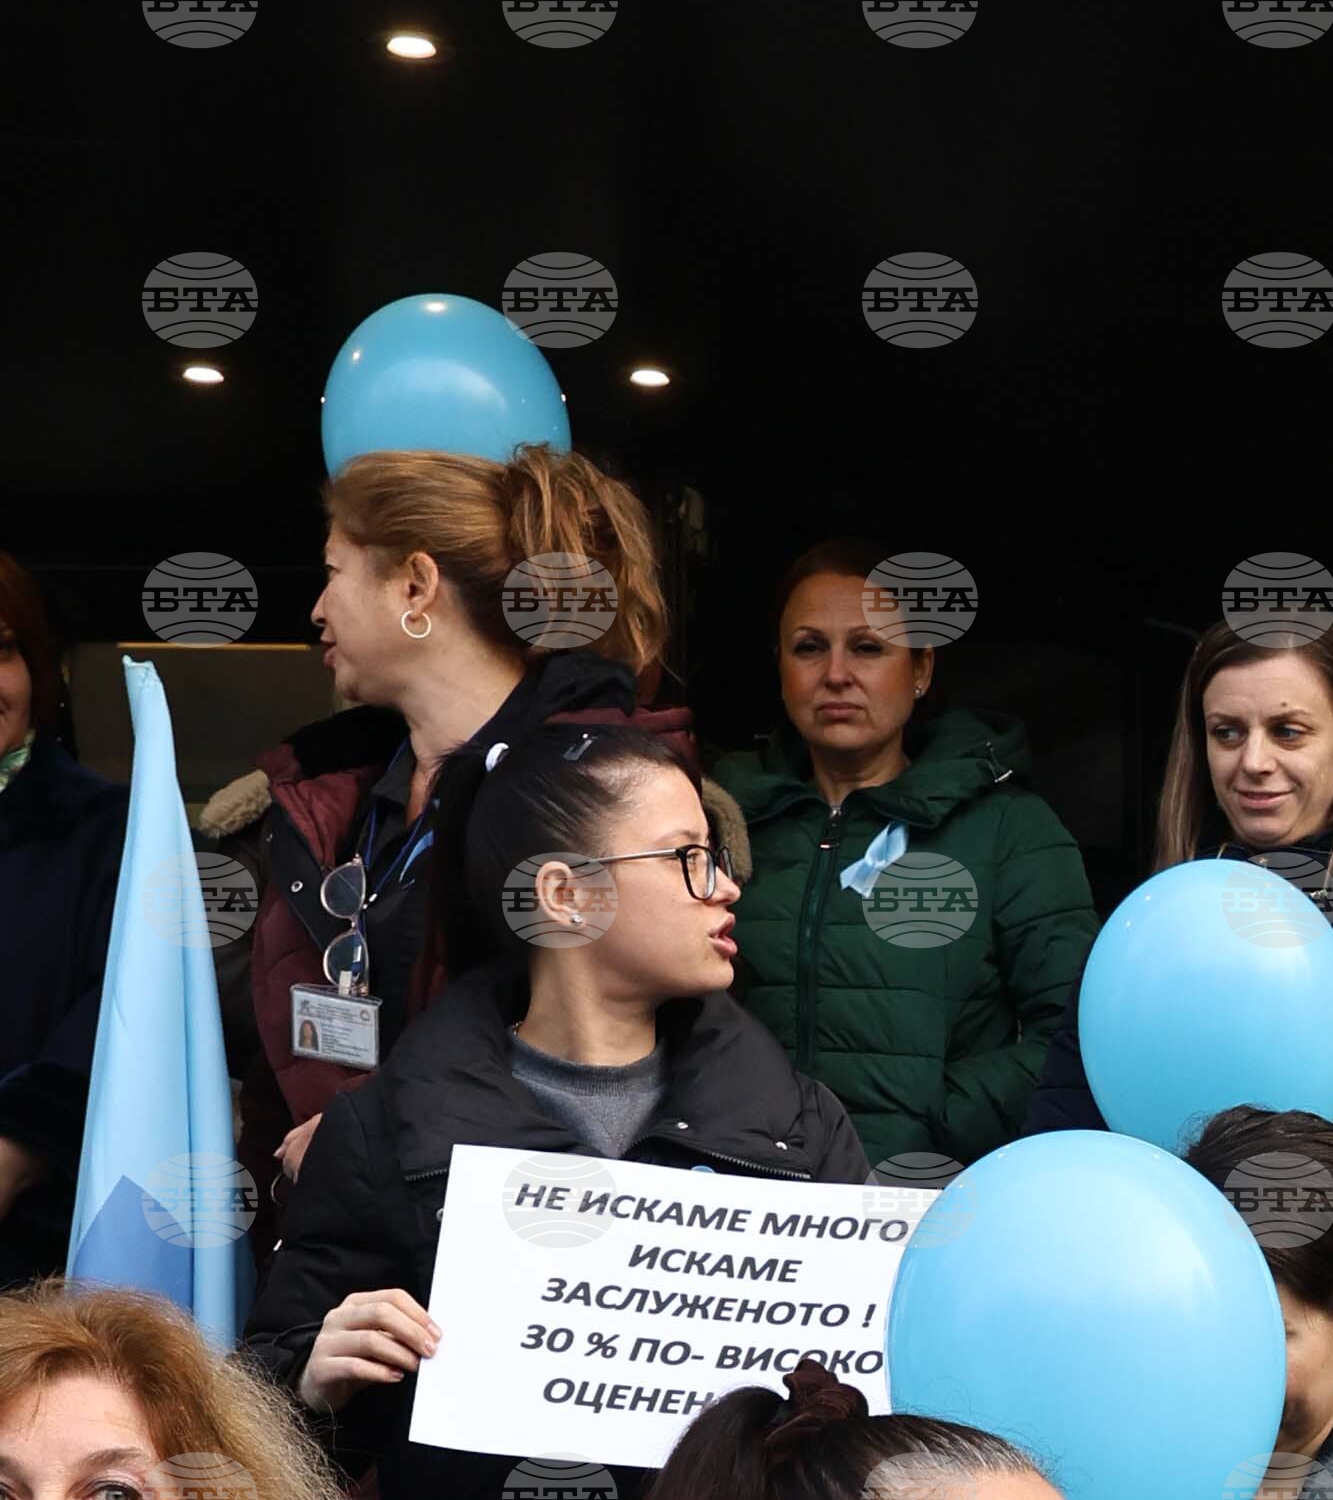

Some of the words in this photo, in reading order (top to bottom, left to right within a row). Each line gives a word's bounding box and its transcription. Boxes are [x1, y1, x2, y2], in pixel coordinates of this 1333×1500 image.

[514, 1183, 572, 1211] НЕ
[576, 1189, 752, 1234] ИСКАМЕ
[759, 1211, 909, 1244] МНОГО
[627, 1244, 803, 1285] ИСКАМЕ
[541, 1277, 850, 1328] ЗАСЛУЖЕНОТО
[520, 1324, 575, 1353] 30
[585, 1331, 618, 1360] %
